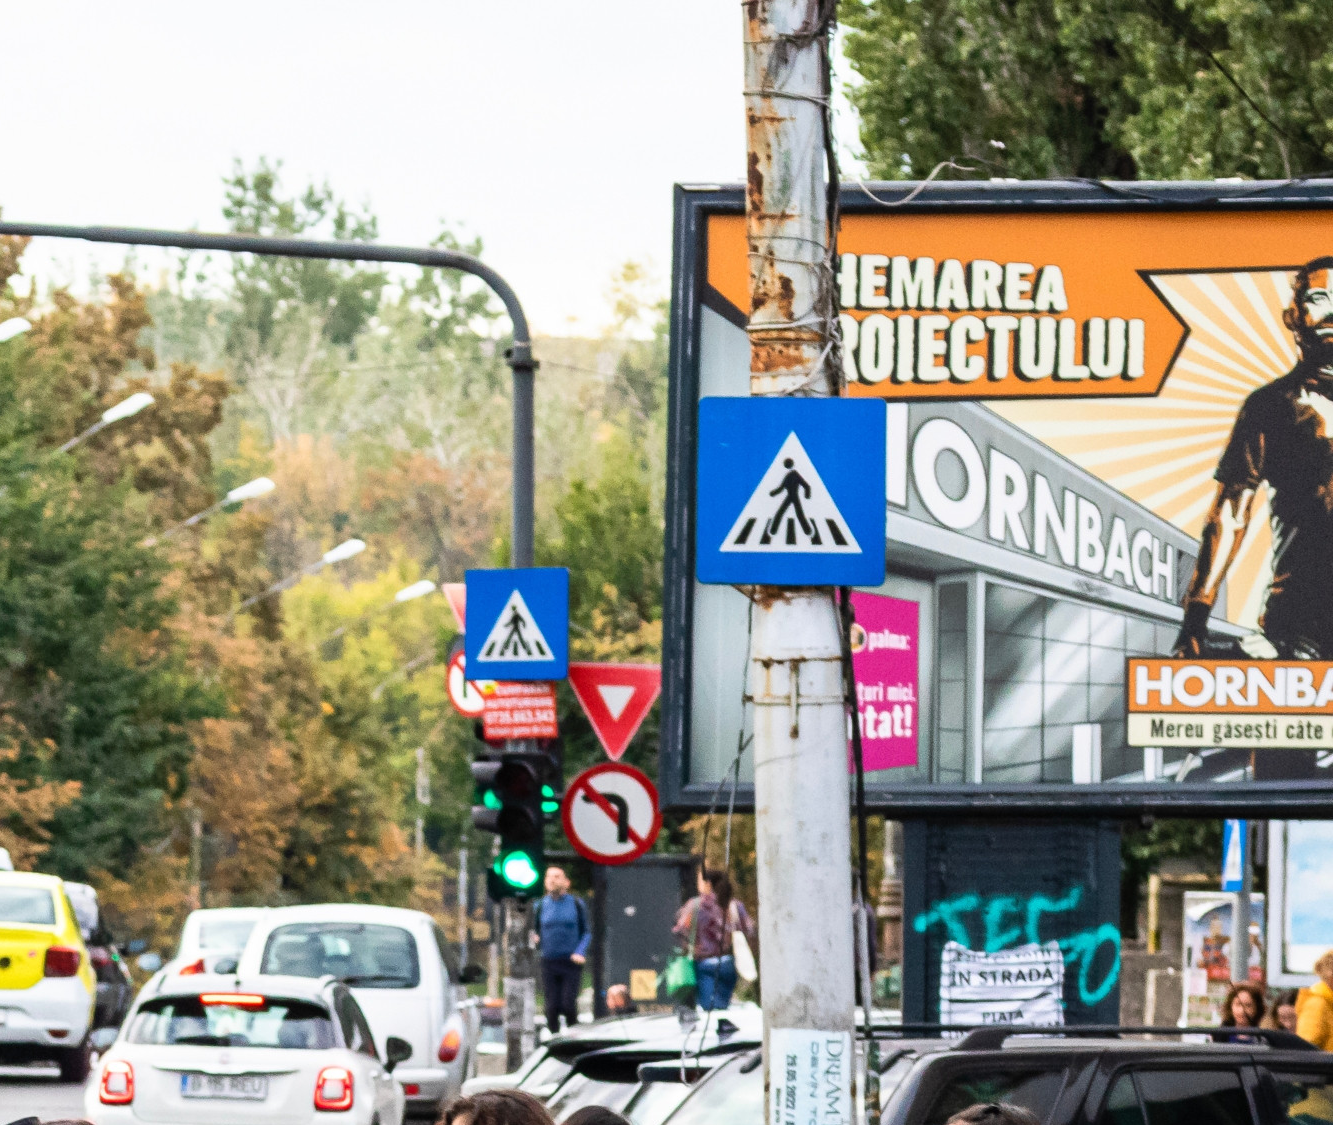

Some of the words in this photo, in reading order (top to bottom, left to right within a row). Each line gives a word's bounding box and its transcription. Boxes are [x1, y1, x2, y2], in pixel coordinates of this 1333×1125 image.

[836, 252, 1068, 311] HEMAREA
[837, 312, 1145, 383] ROIECTULUI
[1151, 718, 1203, 739] Mereu
